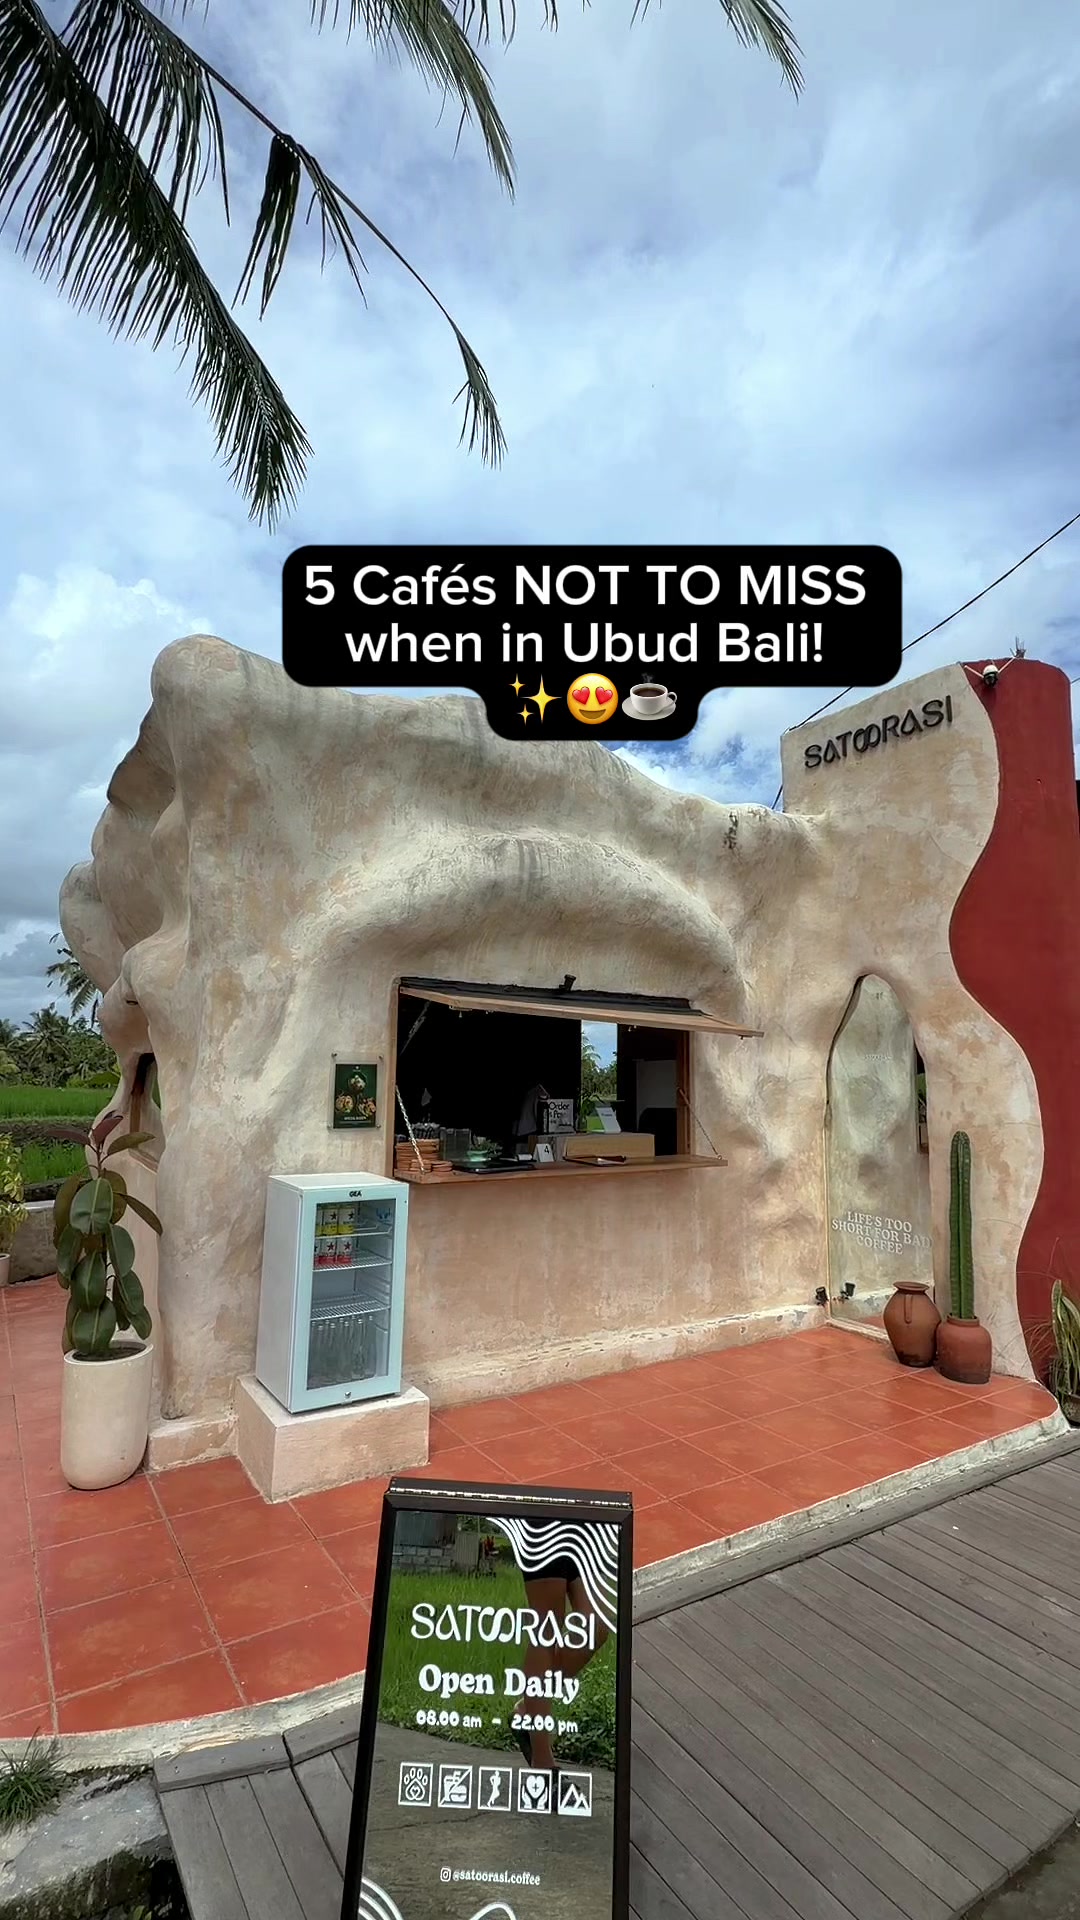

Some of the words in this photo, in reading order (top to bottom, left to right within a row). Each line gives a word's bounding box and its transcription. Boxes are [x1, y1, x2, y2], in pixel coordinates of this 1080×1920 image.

[804, 695, 953, 768] SATOORASI
[832, 1219, 871, 1237] SHORT
[874, 1228, 900, 1242] FOR
[903, 1233, 931, 1249] BAD
[847, 1211, 882, 1228] LIFE'S
[885, 1218, 912, 1233] TOO
[857, 1236, 903, 1255] COFFEE
[410, 1603, 595, 1650] SATOORASI
[418, 1664, 494, 1698] Open
[504, 1668, 580, 1704] Daily
[416, 1710, 459, 1728] 08.00
[462, 1715, 482, 1729] am
[511, 1713, 554, 1733] 22.00
[558, 1718, 579, 1736] pm
[452, 1869, 540, 1886] @satoorasi.coffee
